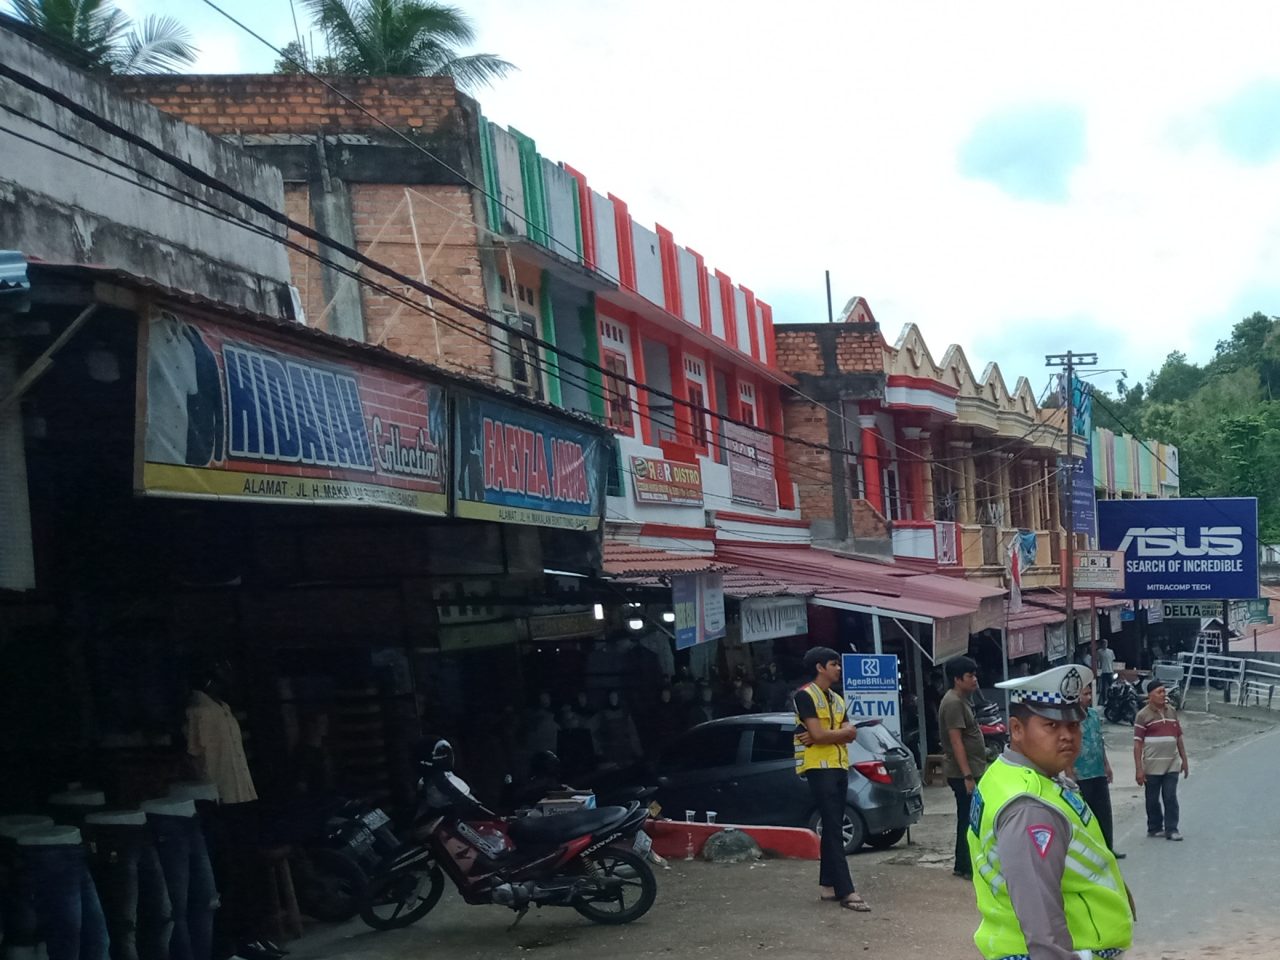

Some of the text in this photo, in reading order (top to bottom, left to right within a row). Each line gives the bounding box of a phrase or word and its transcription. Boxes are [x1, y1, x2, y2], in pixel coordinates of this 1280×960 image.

[222, 343, 376, 472] HIDAYAH
[372, 414, 440, 478] Collection
[664, 463, 673, 482] R
[673, 467, 700, 485] DISTRO
[243, 478, 288, 496] ALAMAT
[1117, 526, 1244, 557] ASUS
[1127, 560, 1166, 573] SEARCH
[1169, 560, 1181, 573] OF
[1164, 605, 1201, 617] DELTA
[847, 677, 896, 687] AgenBRILink
[851, 700, 895, 716] ATM
